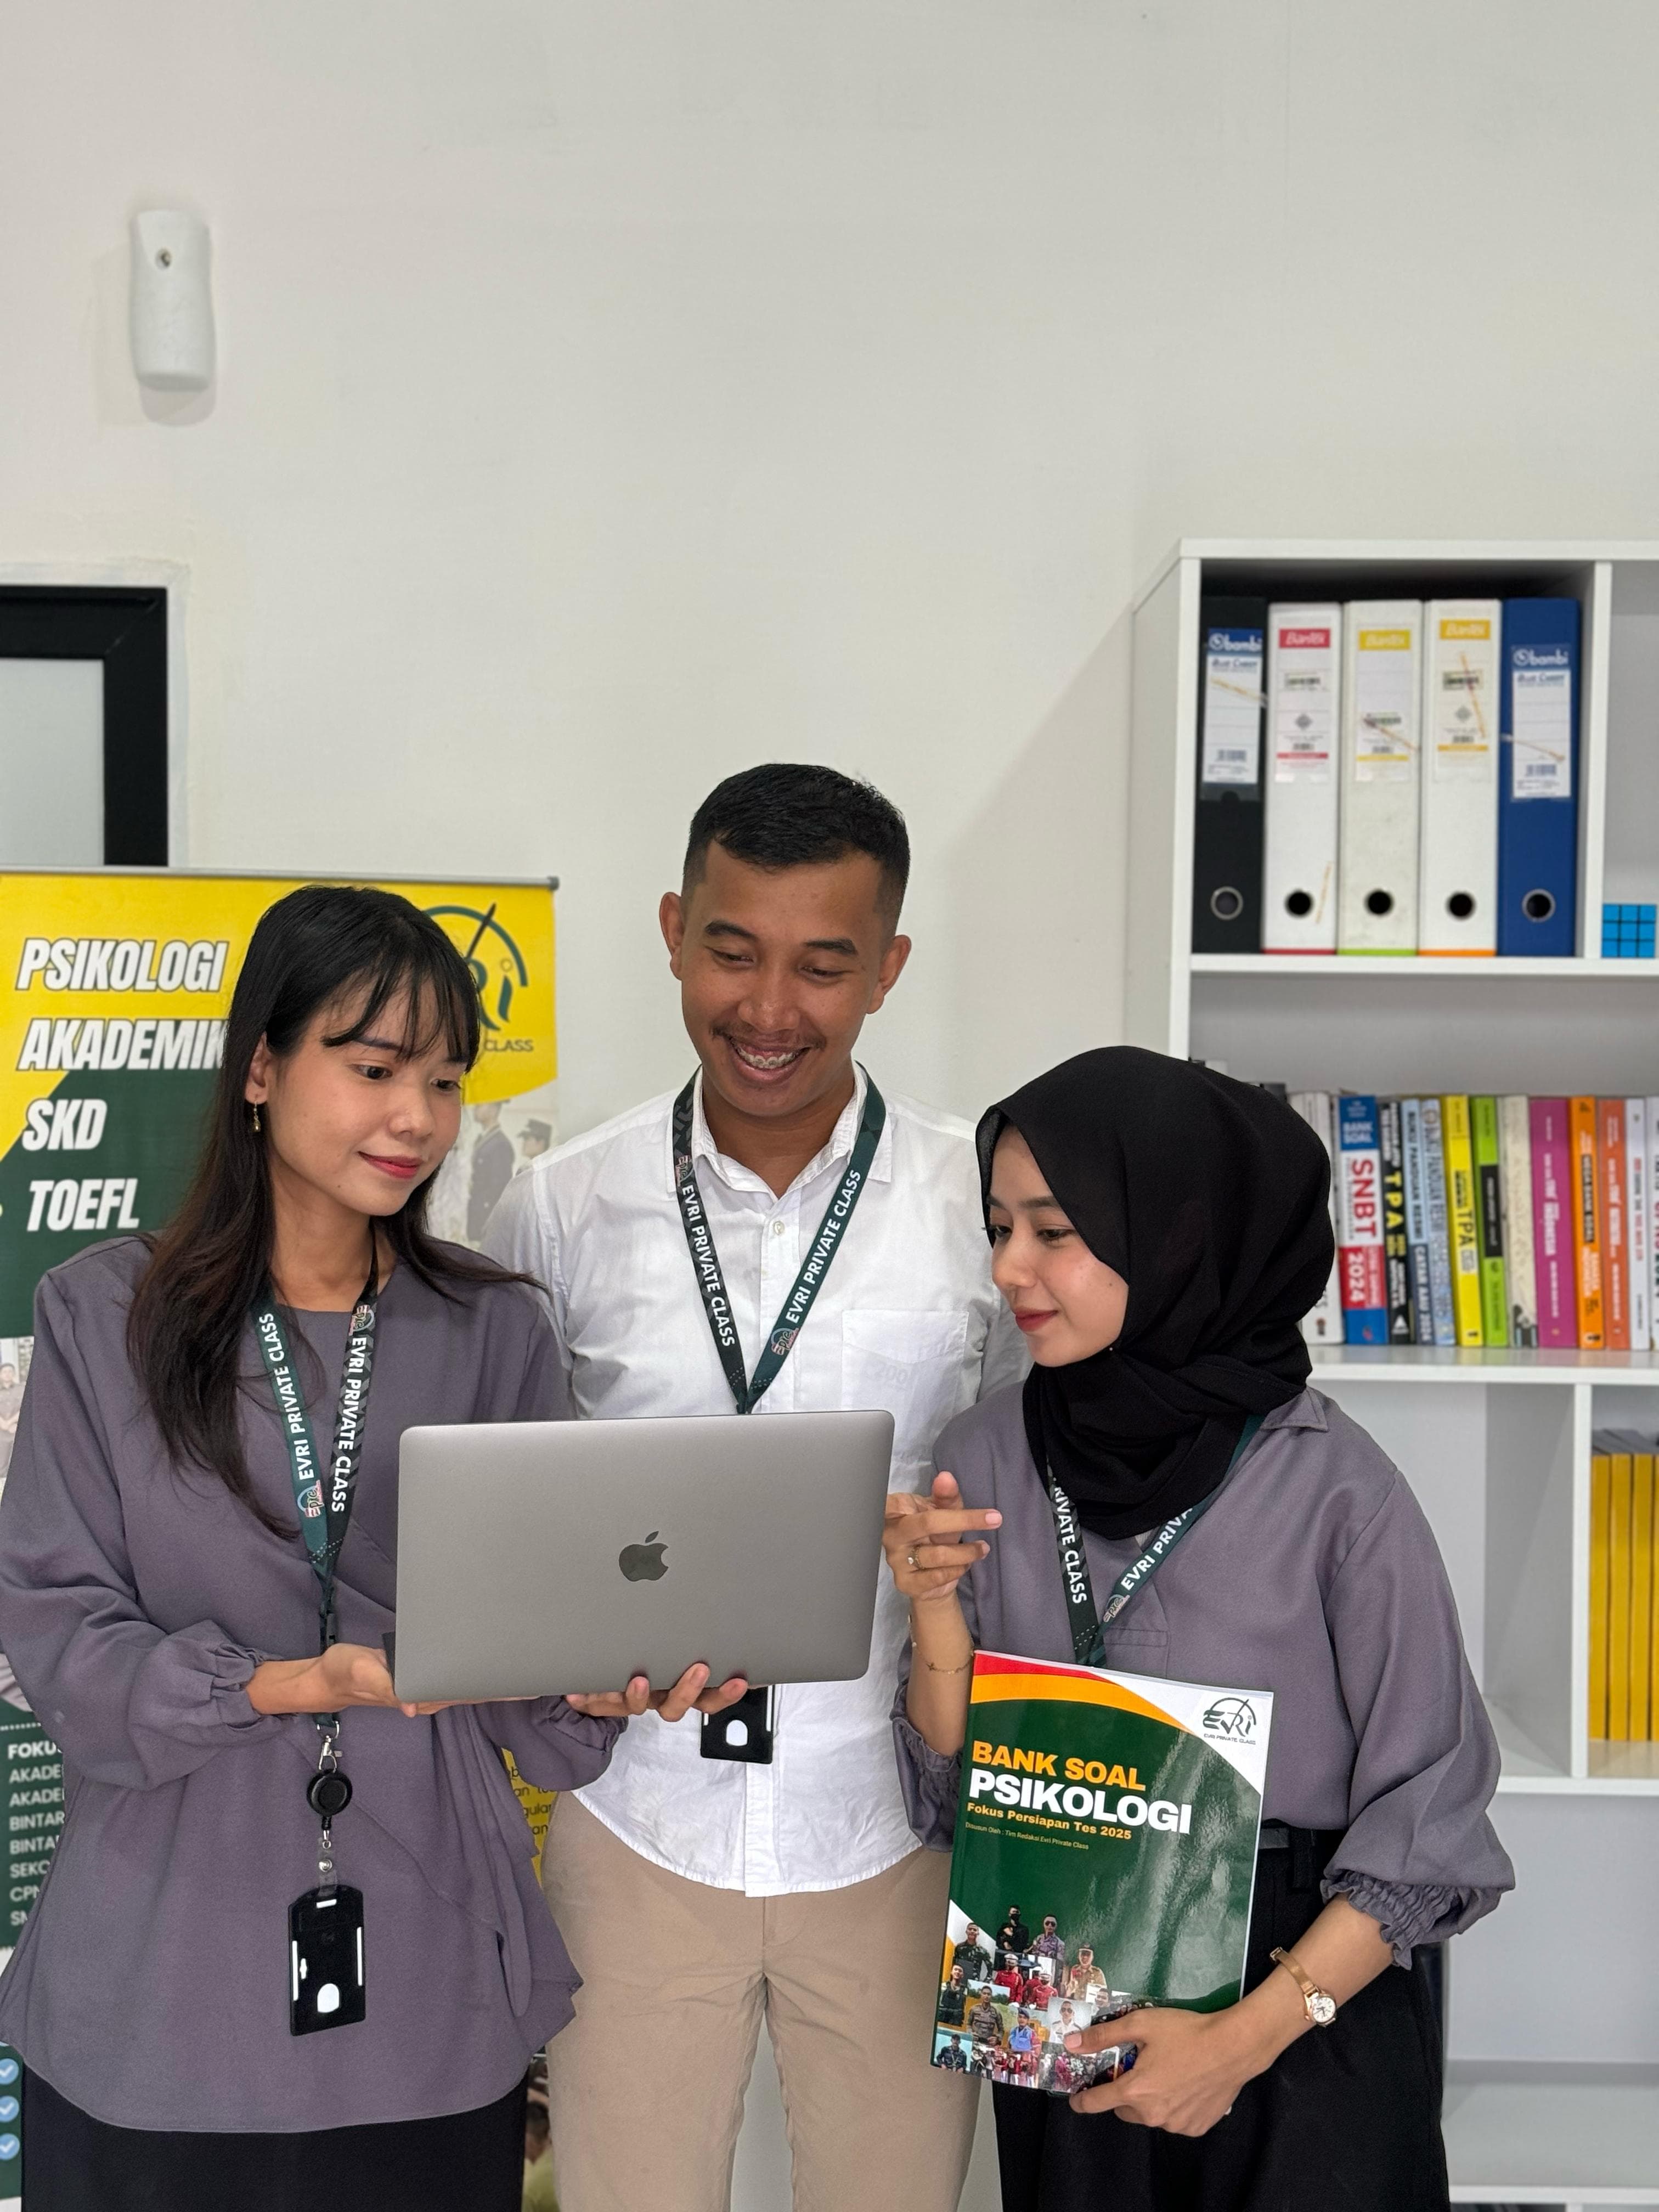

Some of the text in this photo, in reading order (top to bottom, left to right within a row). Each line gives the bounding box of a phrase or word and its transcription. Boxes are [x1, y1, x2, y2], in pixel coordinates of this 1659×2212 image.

[15, 938, 229, 992] PSIKOLOGI
[483, 1039, 533, 1052] CLASS
[21, 1097, 108, 1151] SKD
[1407, 1111, 1417, 1143] BUKU
[26, 1178, 140, 1232] TOEFL
[1351, 1158, 1376, 1238] SNBT
[785, 1169, 861, 1324] EVRI PRIVATE CLASS
[1458, 1209, 1474, 1248] TPA
[681, 1185, 735, 1347] EVRI PRIVATE CLASS
[1348, 1252, 1365, 1302] 2024
[259, 1313, 314, 1481] EVRI PRIVATE CLASS
[331, 1337, 367, 1513] EVRI PRIVATE CLASS
[1054, 1485, 1087, 1604] RIVATE CLASS
[1121, 1554, 1155, 1591] EVRI
[8, 1740, 63, 1760] FOKU
[9, 1764, 64, 1784] AKADE
[972, 1740, 1146, 1791] BANK SOAL
[967, 1802, 1132, 1840] Fokus Persiapan Tes 2025
[969, 1768, 1192, 1835] PSIKOLOGI
[9, 1835, 59, 1855] BINTA
[988, 1826, 1001, 1835] Oleh
[1005, 1829, 1016, 1838] Tim
[1017, 1832, 1040, 1842] Redaksi
[1040, 1836, 1051, 1844] Evri
[1052, 1838, 1073, 1847] Private
[1073, 1841, 1089, 1850] Class
